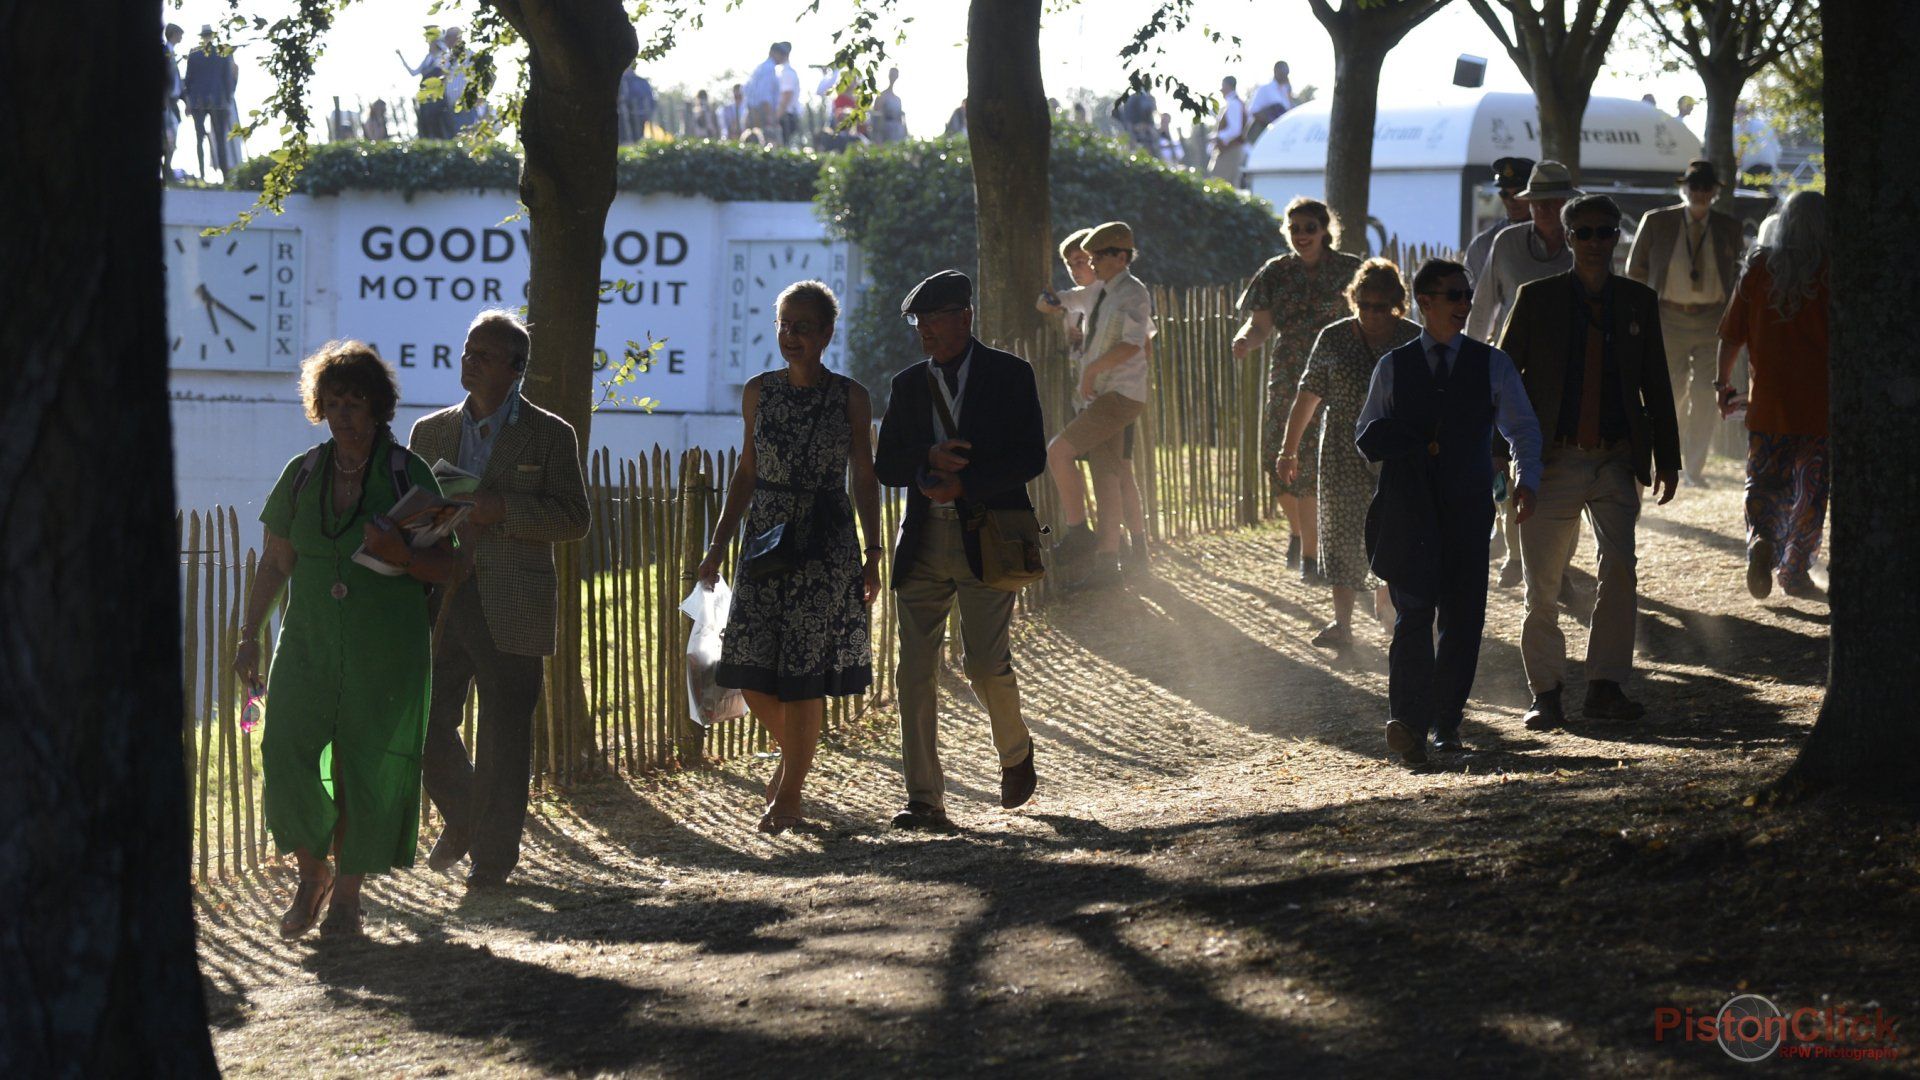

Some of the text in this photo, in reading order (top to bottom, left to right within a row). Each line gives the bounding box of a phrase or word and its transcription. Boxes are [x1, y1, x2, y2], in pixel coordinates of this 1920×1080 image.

[1579, 126, 1641, 145] ream
[362, 226, 688, 267] GOODOD
[276, 242, 294, 355] ROLEX
[360, 275, 688, 306] MOTOR CUIT
[729, 253, 745, 368] ROLEX
